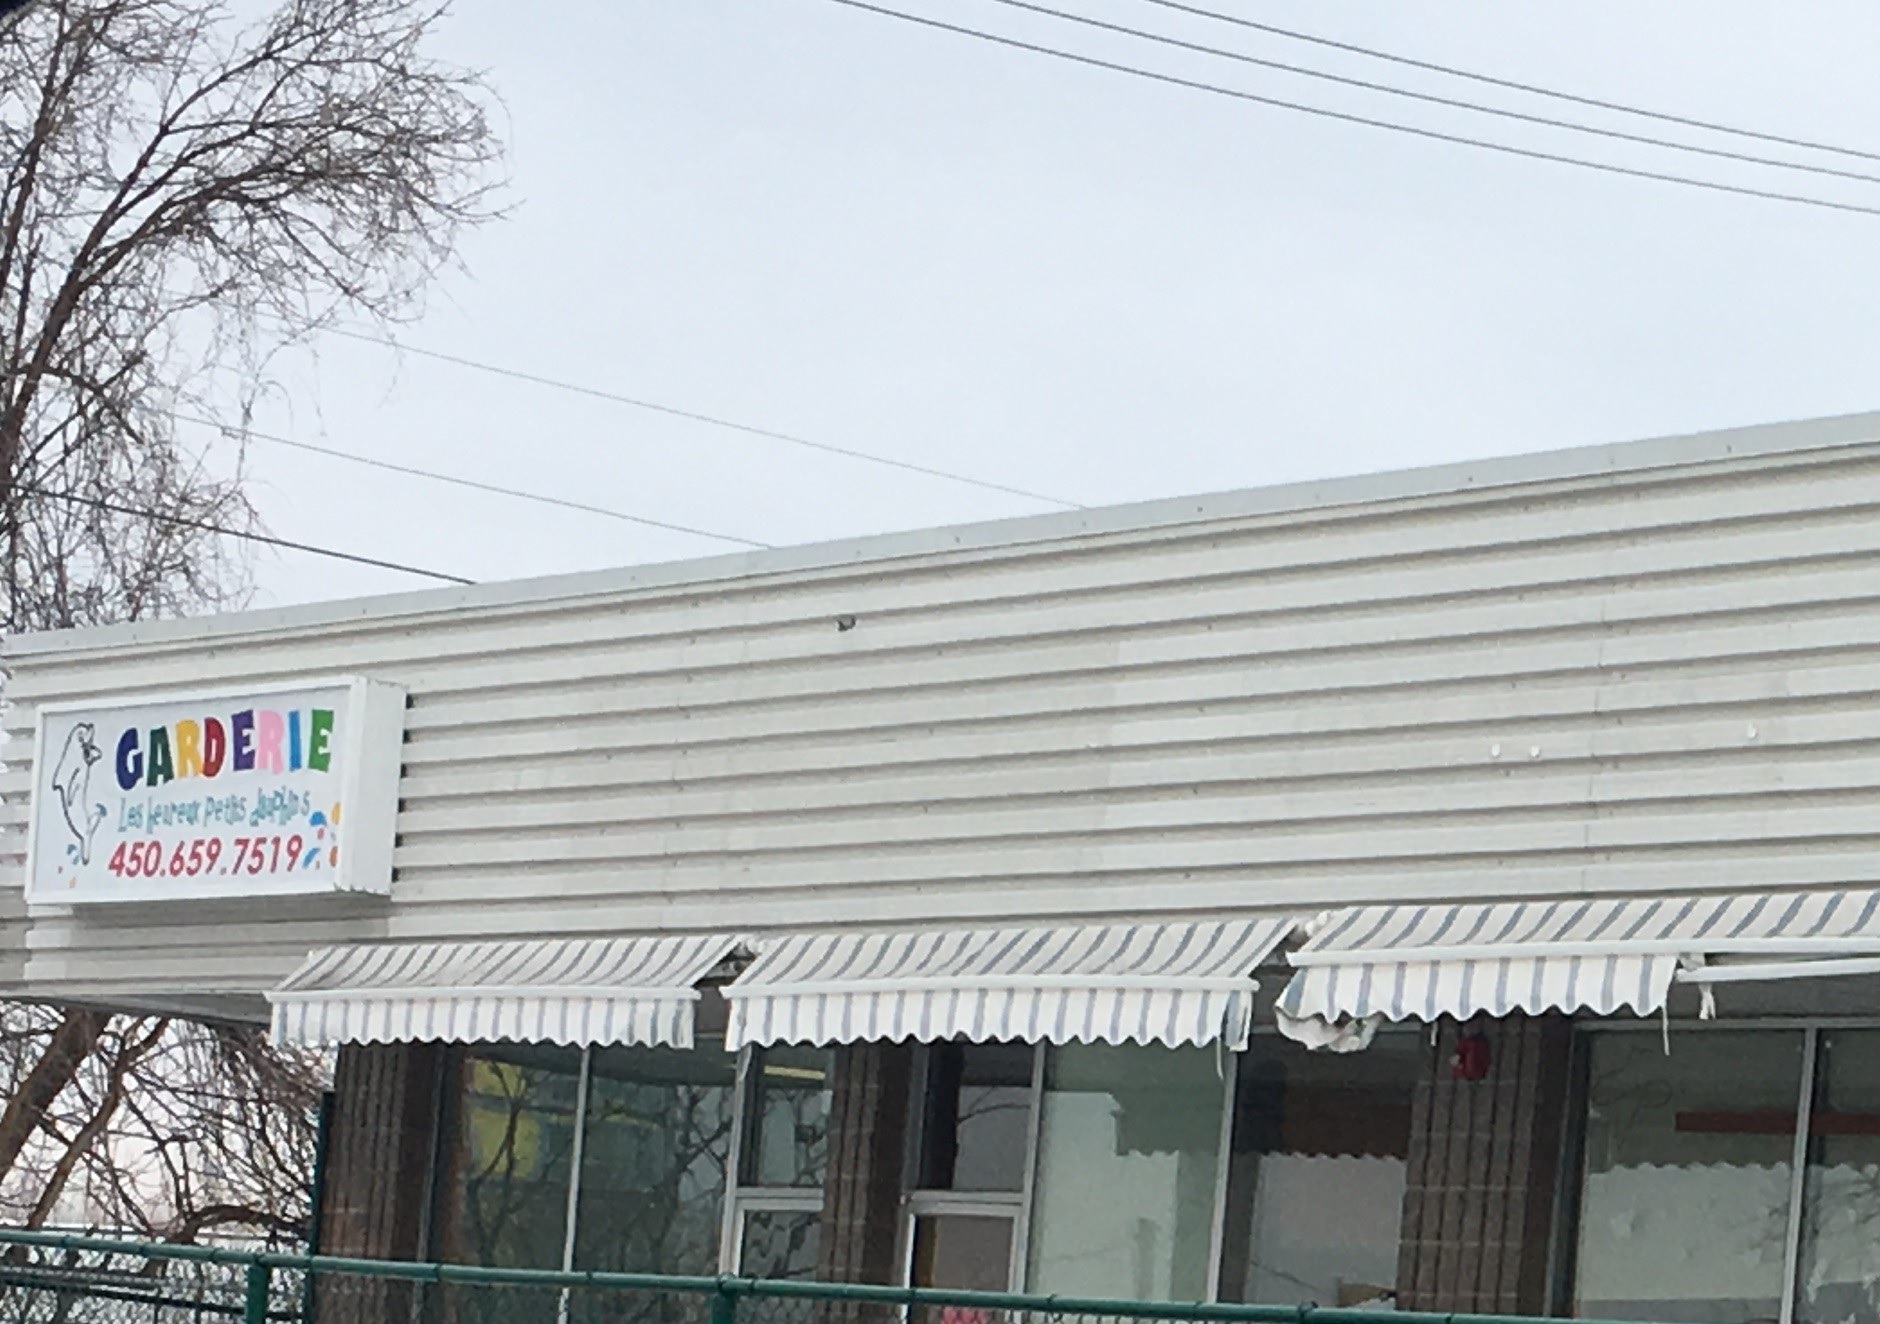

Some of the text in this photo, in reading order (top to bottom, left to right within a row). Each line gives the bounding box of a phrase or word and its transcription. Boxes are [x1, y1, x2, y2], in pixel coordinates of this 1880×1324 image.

[115, 709, 335, 791] GARDERIE
[117, 797, 143, 833] Les
[109, 834, 303, 878] 450.659.7519
